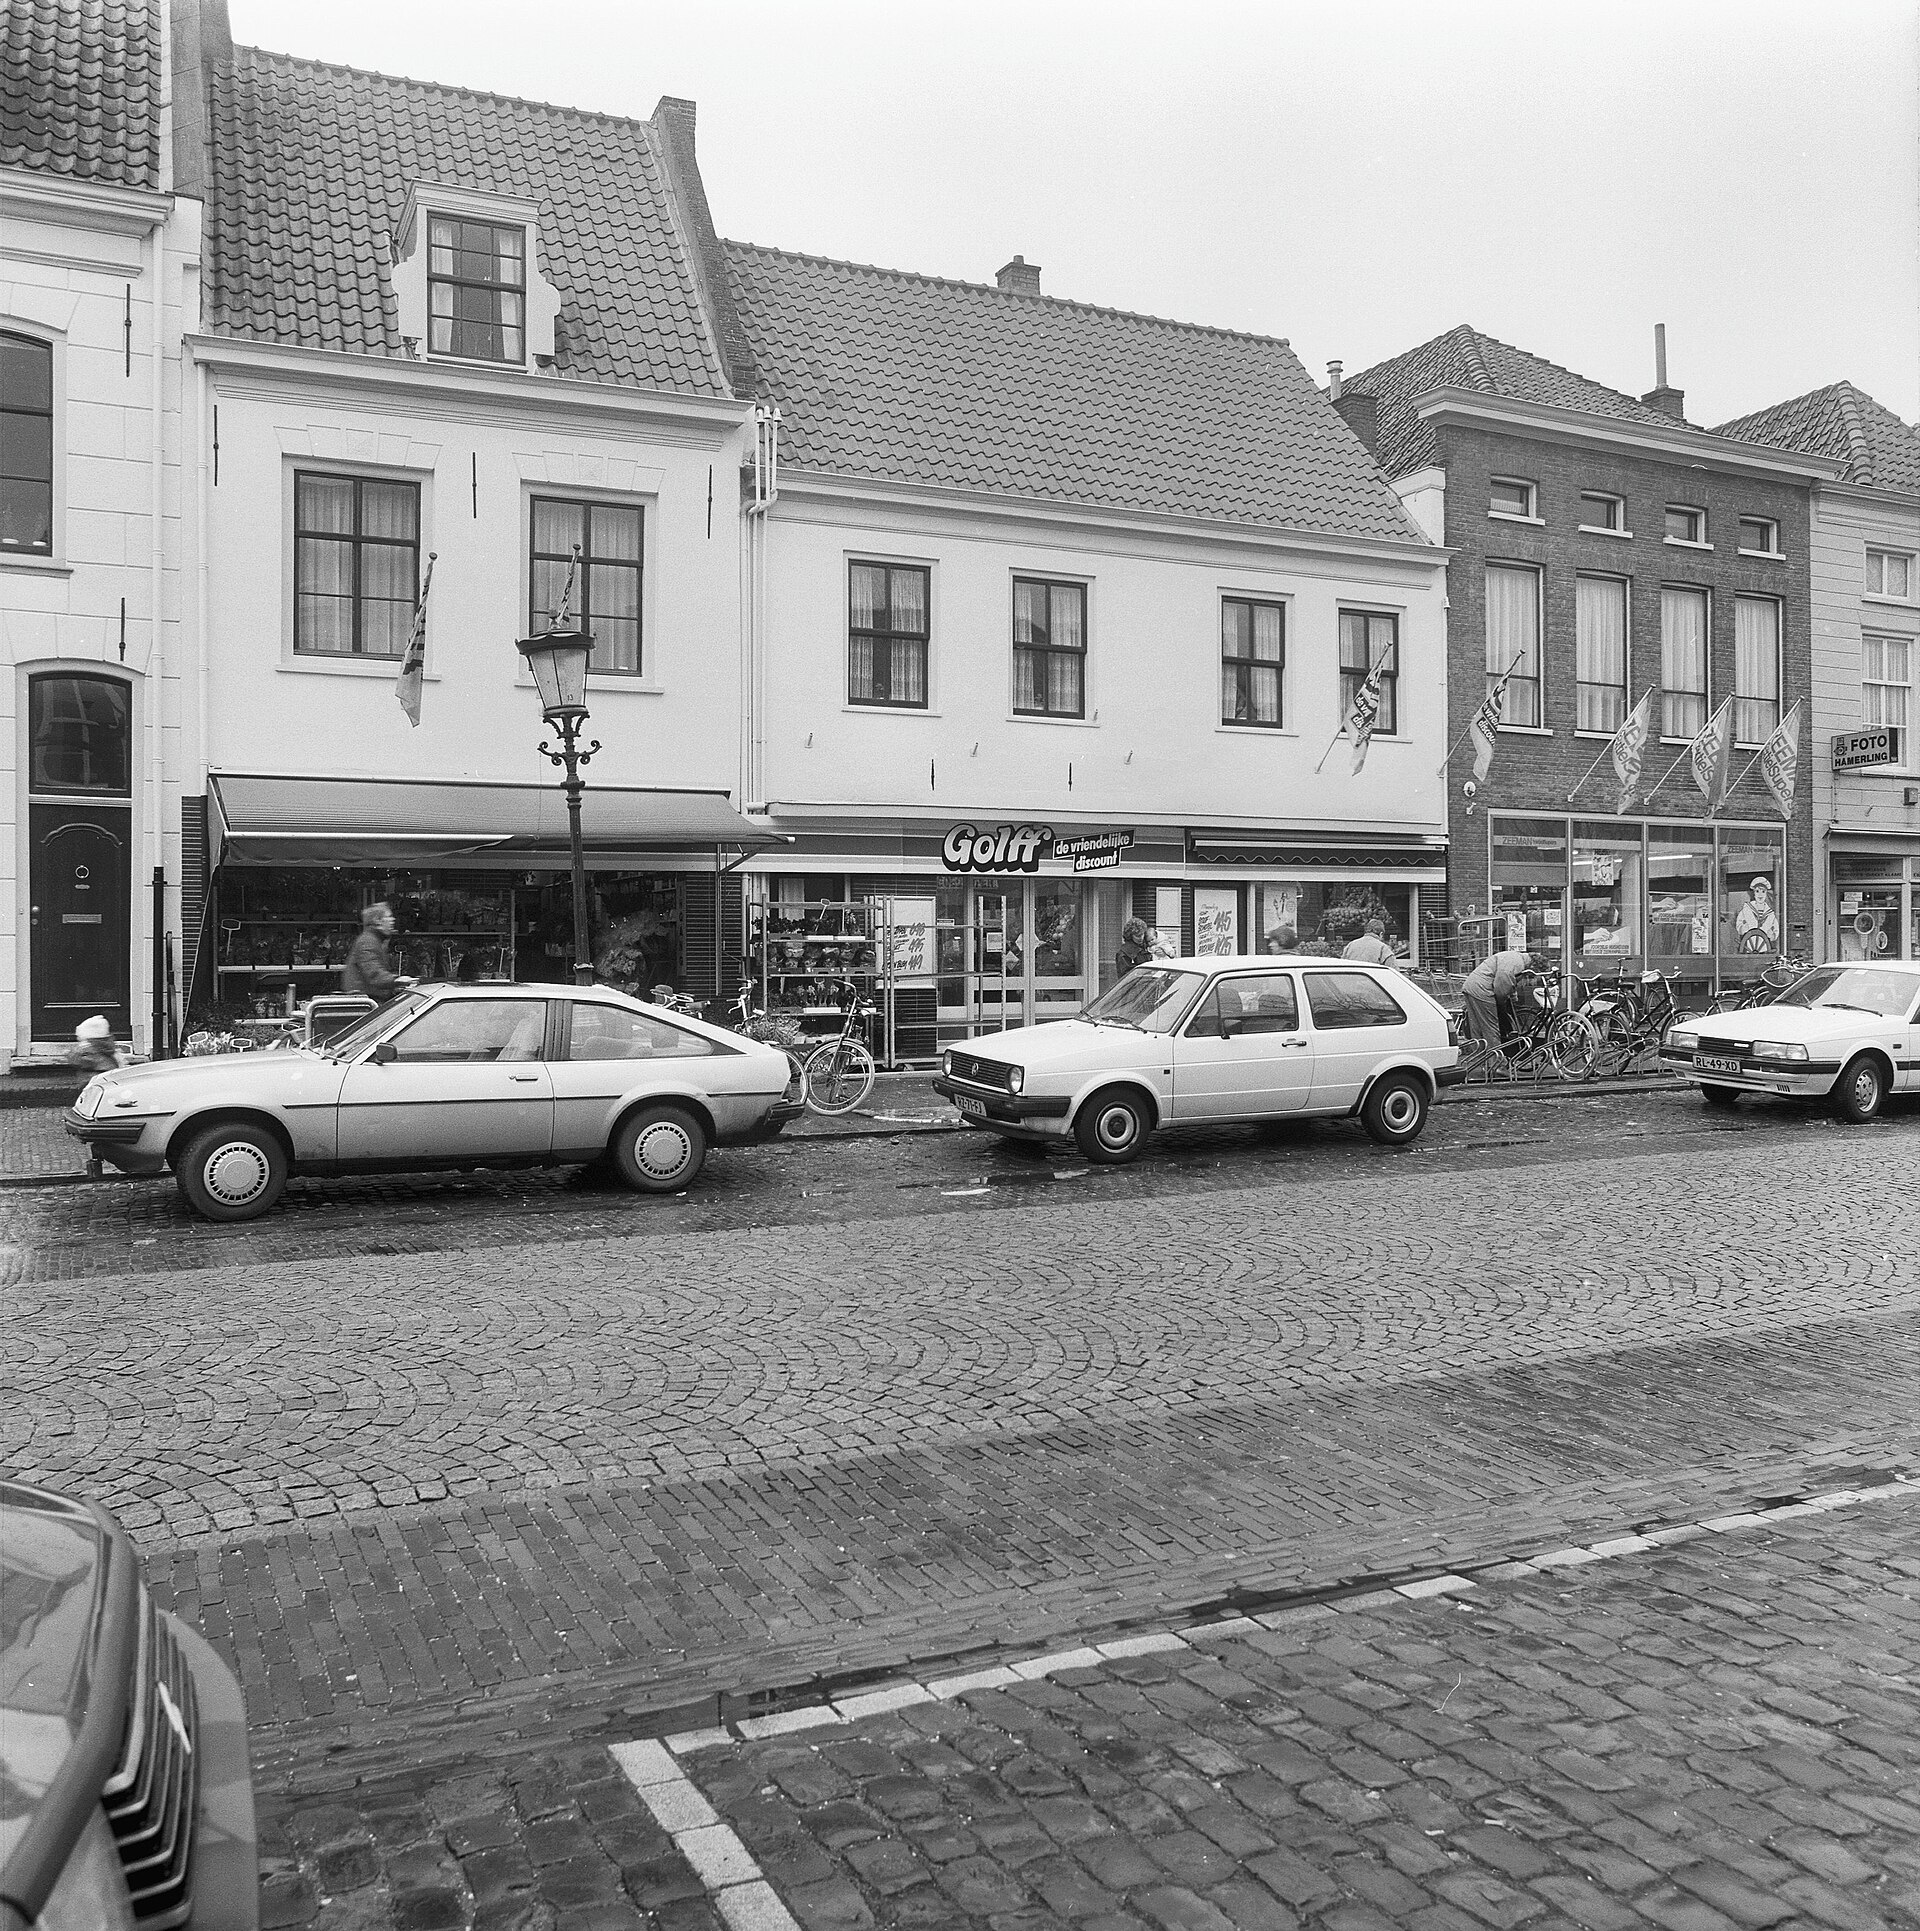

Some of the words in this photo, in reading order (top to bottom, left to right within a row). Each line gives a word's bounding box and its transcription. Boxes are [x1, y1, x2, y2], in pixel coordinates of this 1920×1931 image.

[1851, 735, 1887, 751] FOTO
[1834, 752, 1888, 767] HAMERLING
[943, 822, 1053, 867] Golff
[1056, 840, 1069, 855] de
[1070, 832, 1130, 854] vriendelijke
[1502, 836, 1533, 846] ZEEMAN
[1727, 845, 1753, 854] ZEEMAN
[1075, 850, 1118, 871] discount
[1695, 1057, 1737, 1071] RL-49-XD
